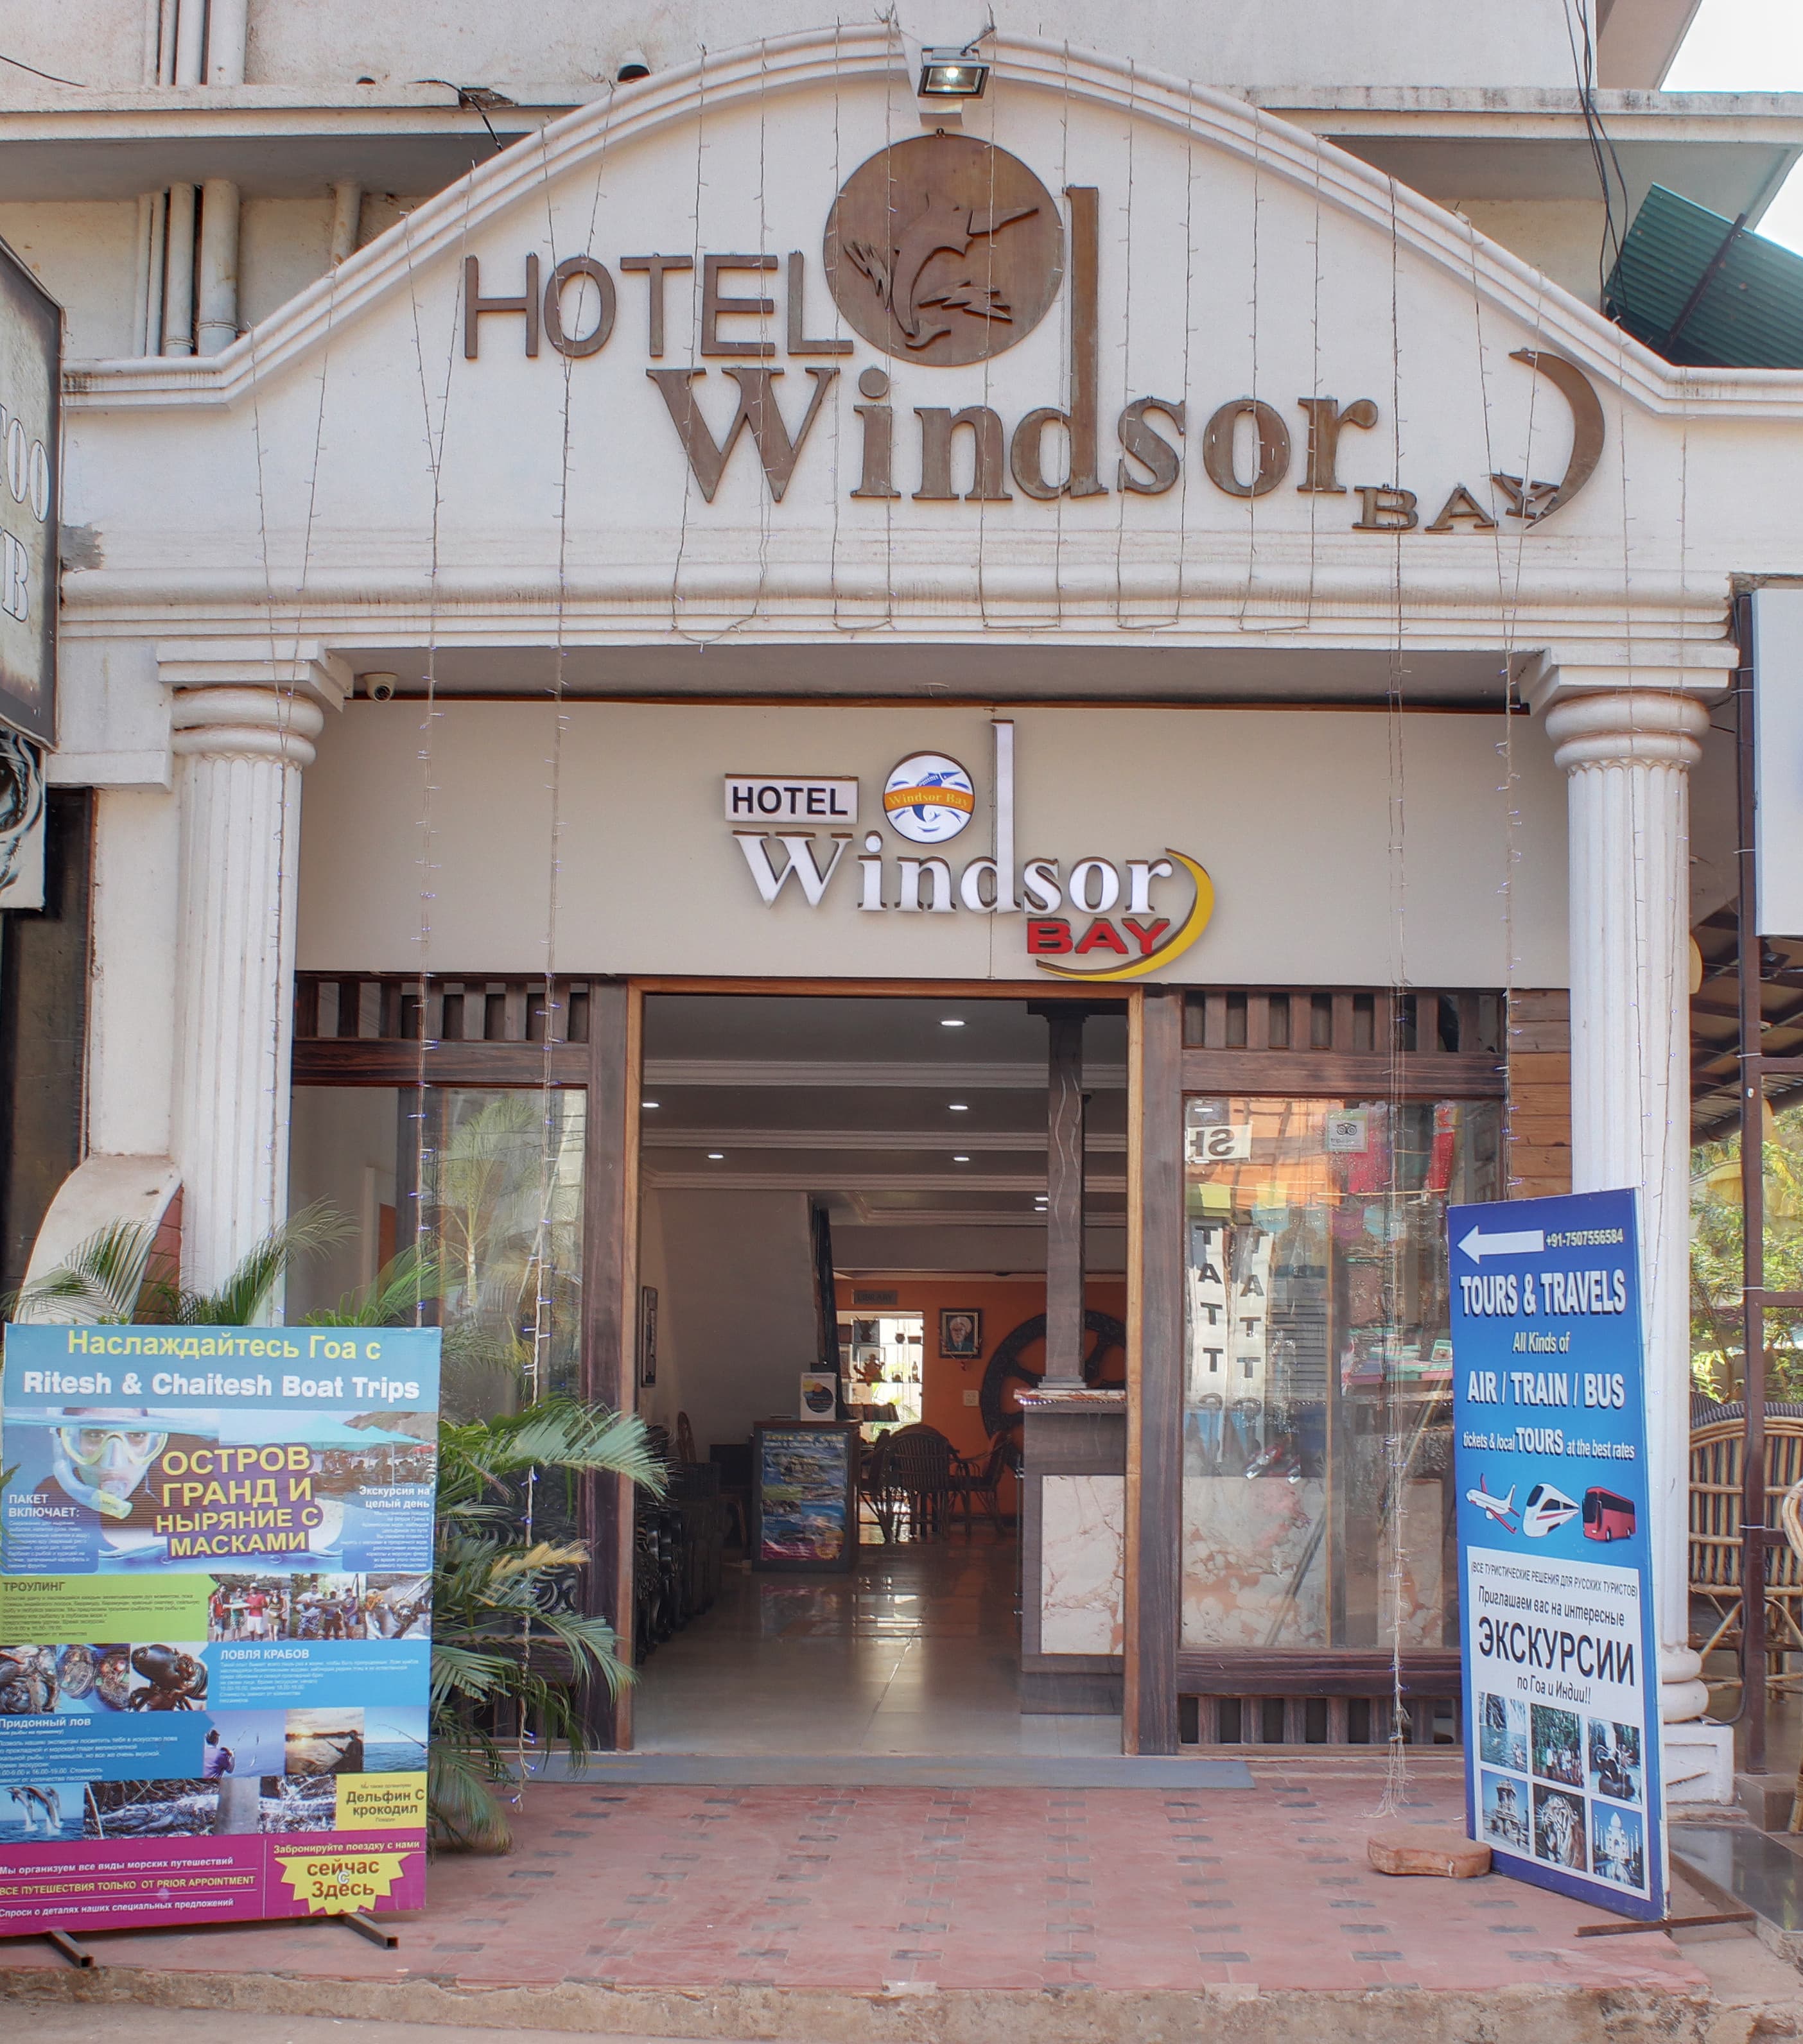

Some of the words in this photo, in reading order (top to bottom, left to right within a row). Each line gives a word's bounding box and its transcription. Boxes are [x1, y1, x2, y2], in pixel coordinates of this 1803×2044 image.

[464, 250, 854, 359] HOTEL
[646, 186, 1379, 503] Windsor
[1352, 472, 1560, 531] BAY
[732, 786, 849, 817] HOTEL
[889, 792, 943, 806] Windsor
[946, 792, 969, 809] Bay
[732, 720, 1174, 915] Windsor
[1027, 917, 1171, 955] BAY
[1545, 1227, 1624, 1248] +91-7507556584
[1459, 1274, 1519, 1316] TOURS
[1523, 1273, 1537, 1316] &
[1540, 1269, 1626, 1315] TRAVELS
[68, 1329, 300, 1360] Наслаждайтесь
[309, 1335, 356, 1360] Гоа
[366, 1341, 381, 1360] с
[1512, 1331, 1527, 1352] All
[1528, 1331, 1556, 1353] Kinds
[1558, 1331, 1571, 1353] of
[23, 1371, 112, 1394] Ritesh
[122, 1372, 143, 1395] &
[152, 1373, 272, 1397] Chaitesh
[282, 1376, 344, 1398] Boat
[351, 1377, 421, 1403] Trips
[1467, 1371, 1498, 1403] AIR
[1501, 1371, 1507, 1403] /
[1510, 1372, 1569, 1406] TRAIN
[1573, 1373, 1579, 1407] /
[1583, 1373, 1625, 1408] BUS
[1463, 1430, 1488, 1450] tickets
[1488, 1432, 1495, 1449] &
[1497, 1433, 1516, 1451] local
[1515, 1426, 1565, 1455] TOURS
[1566, 1441, 1574, 1455] at
[1575, 1439, 1590, 1456] the
[1592, 1439, 1612, 1458] best
[1612, 1441, 1636, 1460] rates
[162, 1446, 311, 1476] ОСТРОВ
[9, 1494, 49, 1504] ПАКЕТ
[162, 1479, 279, 1507] ГРАНД
[290, 1477, 312, 1502] И
[359, 1485, 415, 1498] Экскурсия
[417, 1487, 430, 1496] на
[365, 1498, 401, 1509] целый
[403, 1500, 430, 1509] день
[8, 1507, 80, 1518] ВКЛЮЧАЕТ:
[156, 1509, 293, 1533] НЫРЯНИЕ
[301, 1507, 319, 1527] С
[170, 1531, 306, 1557] МАСКАМИ
[3, 1581, 66, 1592] ТРОУЛИНГ
[1485, 1563, 1531, 1581] ТУРИСТИЧЕСКИЕ
[1531, 1569, 1560, 1586] РЕШЕНИЯ
[1560, 1574, 1573, 1588] ДЛЯ
[1573, 1576, 1602, 1592] РУССКИХ
[1603, 1581, 1639, 1600] ТУРИСТОВ)
[1478, 1585, 1532, 1612] Приглашаем
[1533, 1598, 1549, 1615] вас
[1551, 1602, 1562, 1616] на
[1564, 1602, 1625, 1627] интересные
[220, 1649, 261, 1660] ЛОВЛЯ
[264, 1649, 309, 1659] КРАБОВ
[1478, 1615, 1635, 1688] ЭКСКУРСИИ
[1517, 1677, 1528, 1690] по
[1529, 1675, 1546, 1695] Гоа
[1548, 1682, 1555, 1695] и
[1555, 1679, 1592, 1705] Индии!!
[0, 1717, 66, 1729] Придонный
[69, 1718, 91, 1727] лов
[346, 1790, 412, 1805] Дельфин
[415, 1788, 425, 1801] С
[353, 1804, 418, 1818] крокодил
[274, 1843, 344, 1854] Забронируйте
[346, 1842, 385, 1852] поездку
[395, 1840, 420, 1849] нами
[0, 1867, 16, 1875] Мы
[19, 1864, 76, 1875] организуем
[98, 1862, 125, 1871] виды
[128, 1860, 168, 1871] морских
[171, 1857, 234, 1869] путешествий
[306, 1858, 380, 1876] сейчас
[0, 1887, 19, 1896] ВСЕ
[21, 1882, 94, 1894] ПУТЕШЕСТВИЯ
[98, 1880, 136, 1892] ТОЛЬКО
[142, 1880, 155, 1889] ОТ
[157, 1878, 187, 1889] PRIOR
[188, 1875, 256, 1887] APPOINTMENT
[311, 1880, 375, 1900] Здесь
[0, 1909, 32, 1918] Спроси
[42, 1907, 78, 1917] деталях
[82, 1904, 110, 1913] наших
[112, 1901, 173, 1912] специальных
[175, 1898, 234, 1910] предложений
